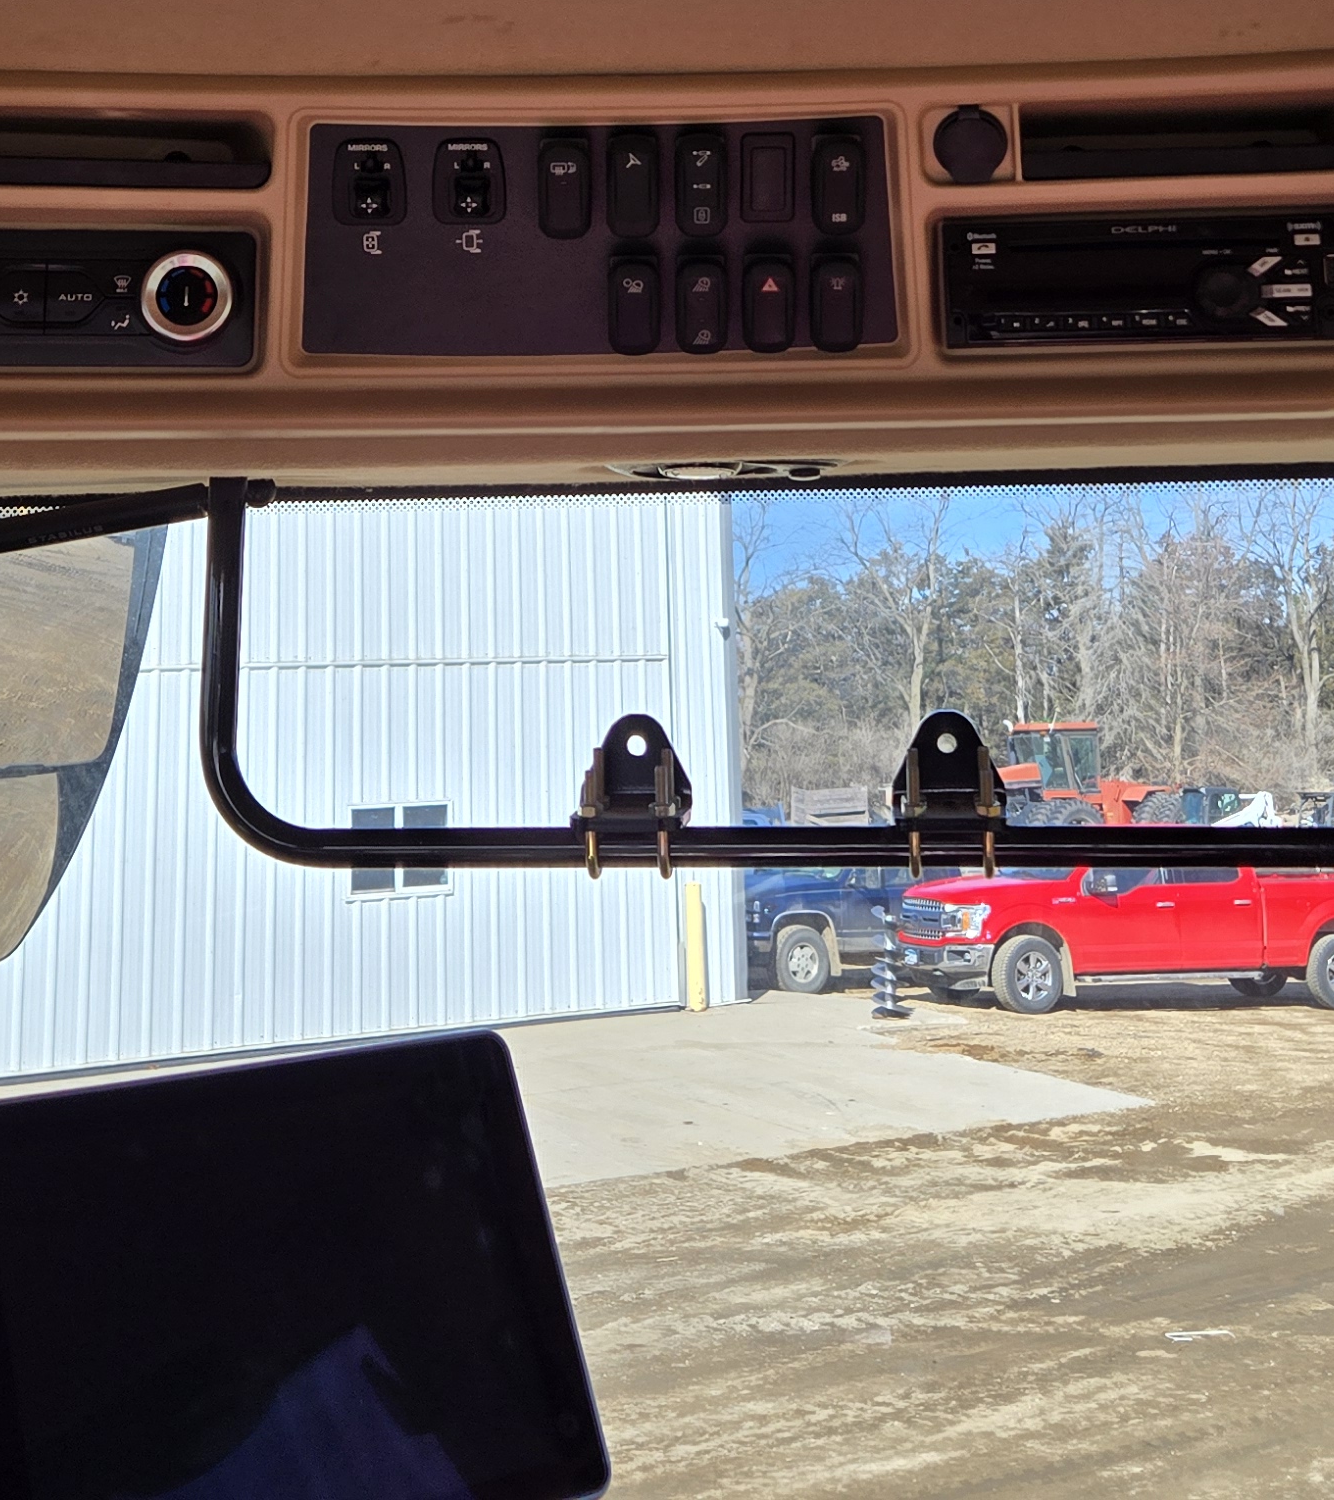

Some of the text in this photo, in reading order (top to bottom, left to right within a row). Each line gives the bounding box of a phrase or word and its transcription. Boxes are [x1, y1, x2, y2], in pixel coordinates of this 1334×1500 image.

[347, 143, 388, 152] MIRRORS
[448, 143, 488, 151] MIRRORS
[354, 162, 391, 170] L R
[454, 161, 490, 169] L R
[831, 213, 847, 222] ISB
[1111, 224, 1176, 234] DELPHI
[58, 293, 93, 301] AUTO
[27, 524, 104, 544] STABILUS
